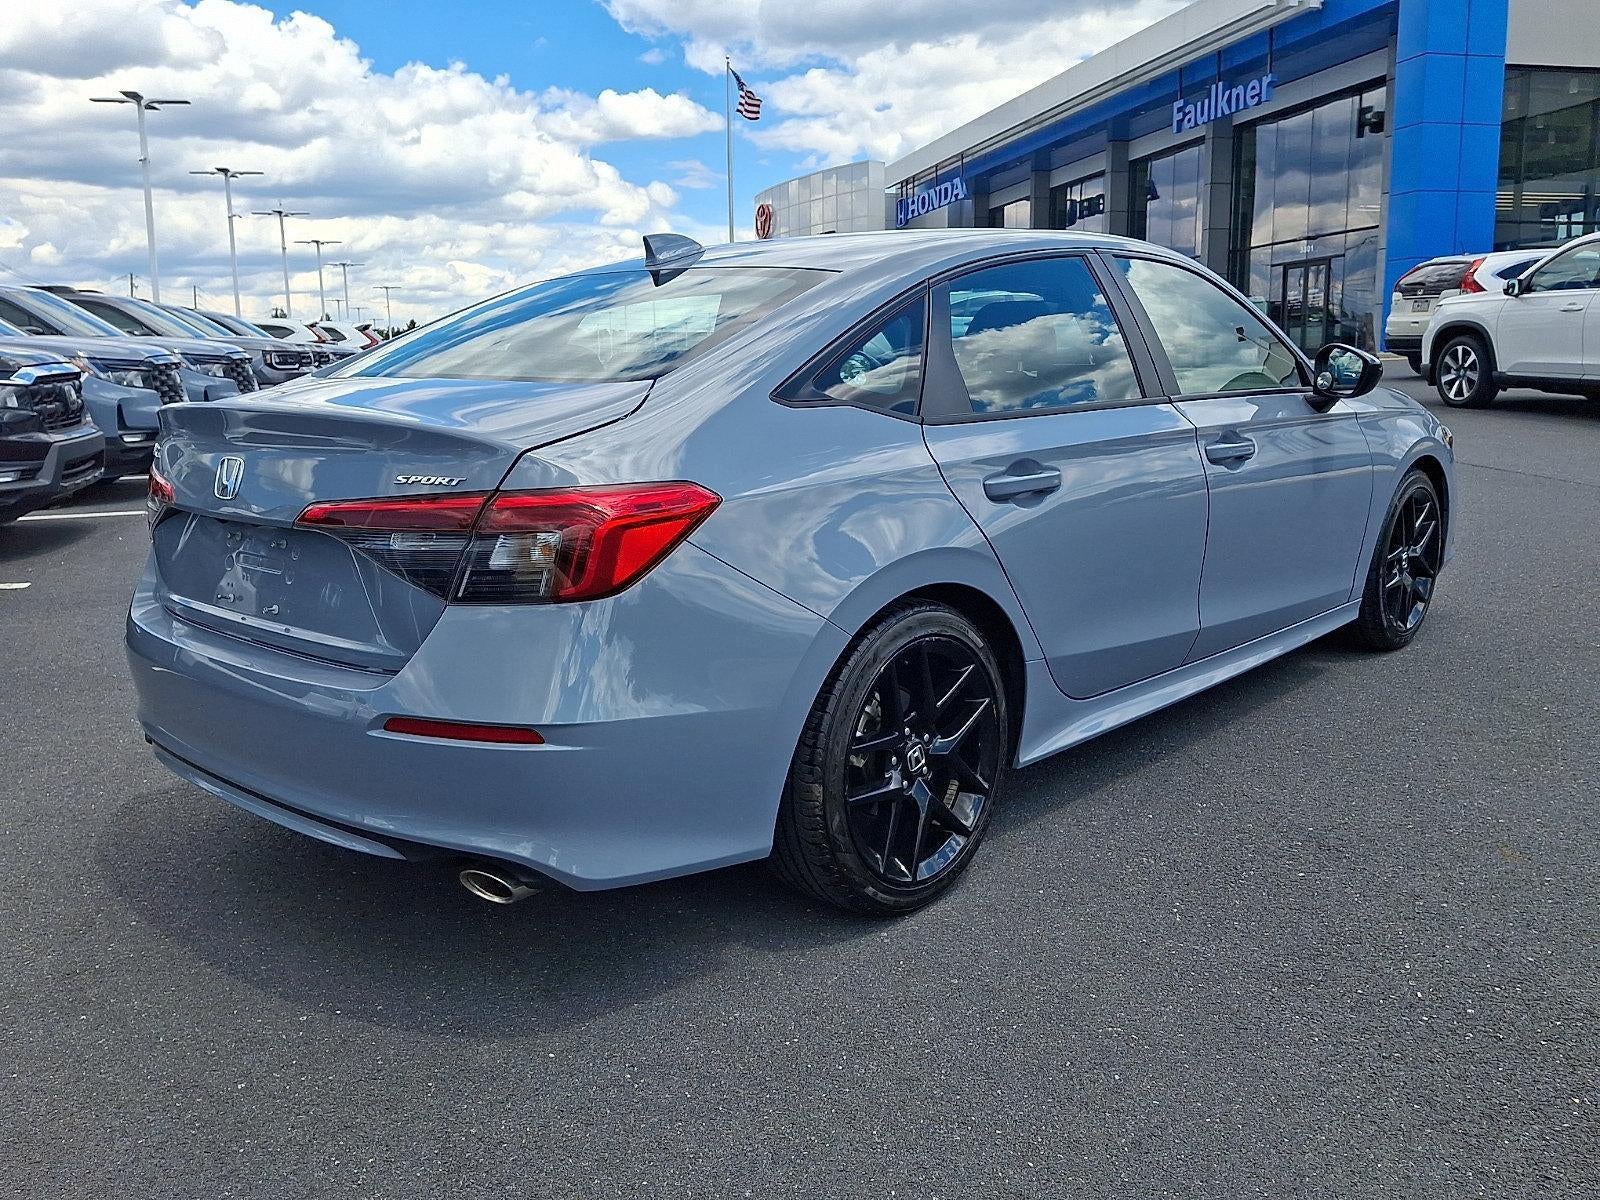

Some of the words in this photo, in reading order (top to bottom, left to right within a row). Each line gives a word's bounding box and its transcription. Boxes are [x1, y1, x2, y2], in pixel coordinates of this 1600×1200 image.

[1172, 73, 1273, 134] Faulkner
[906, 177, 966, 220] HONDA
[394, 475, 467, 486] SPORT
